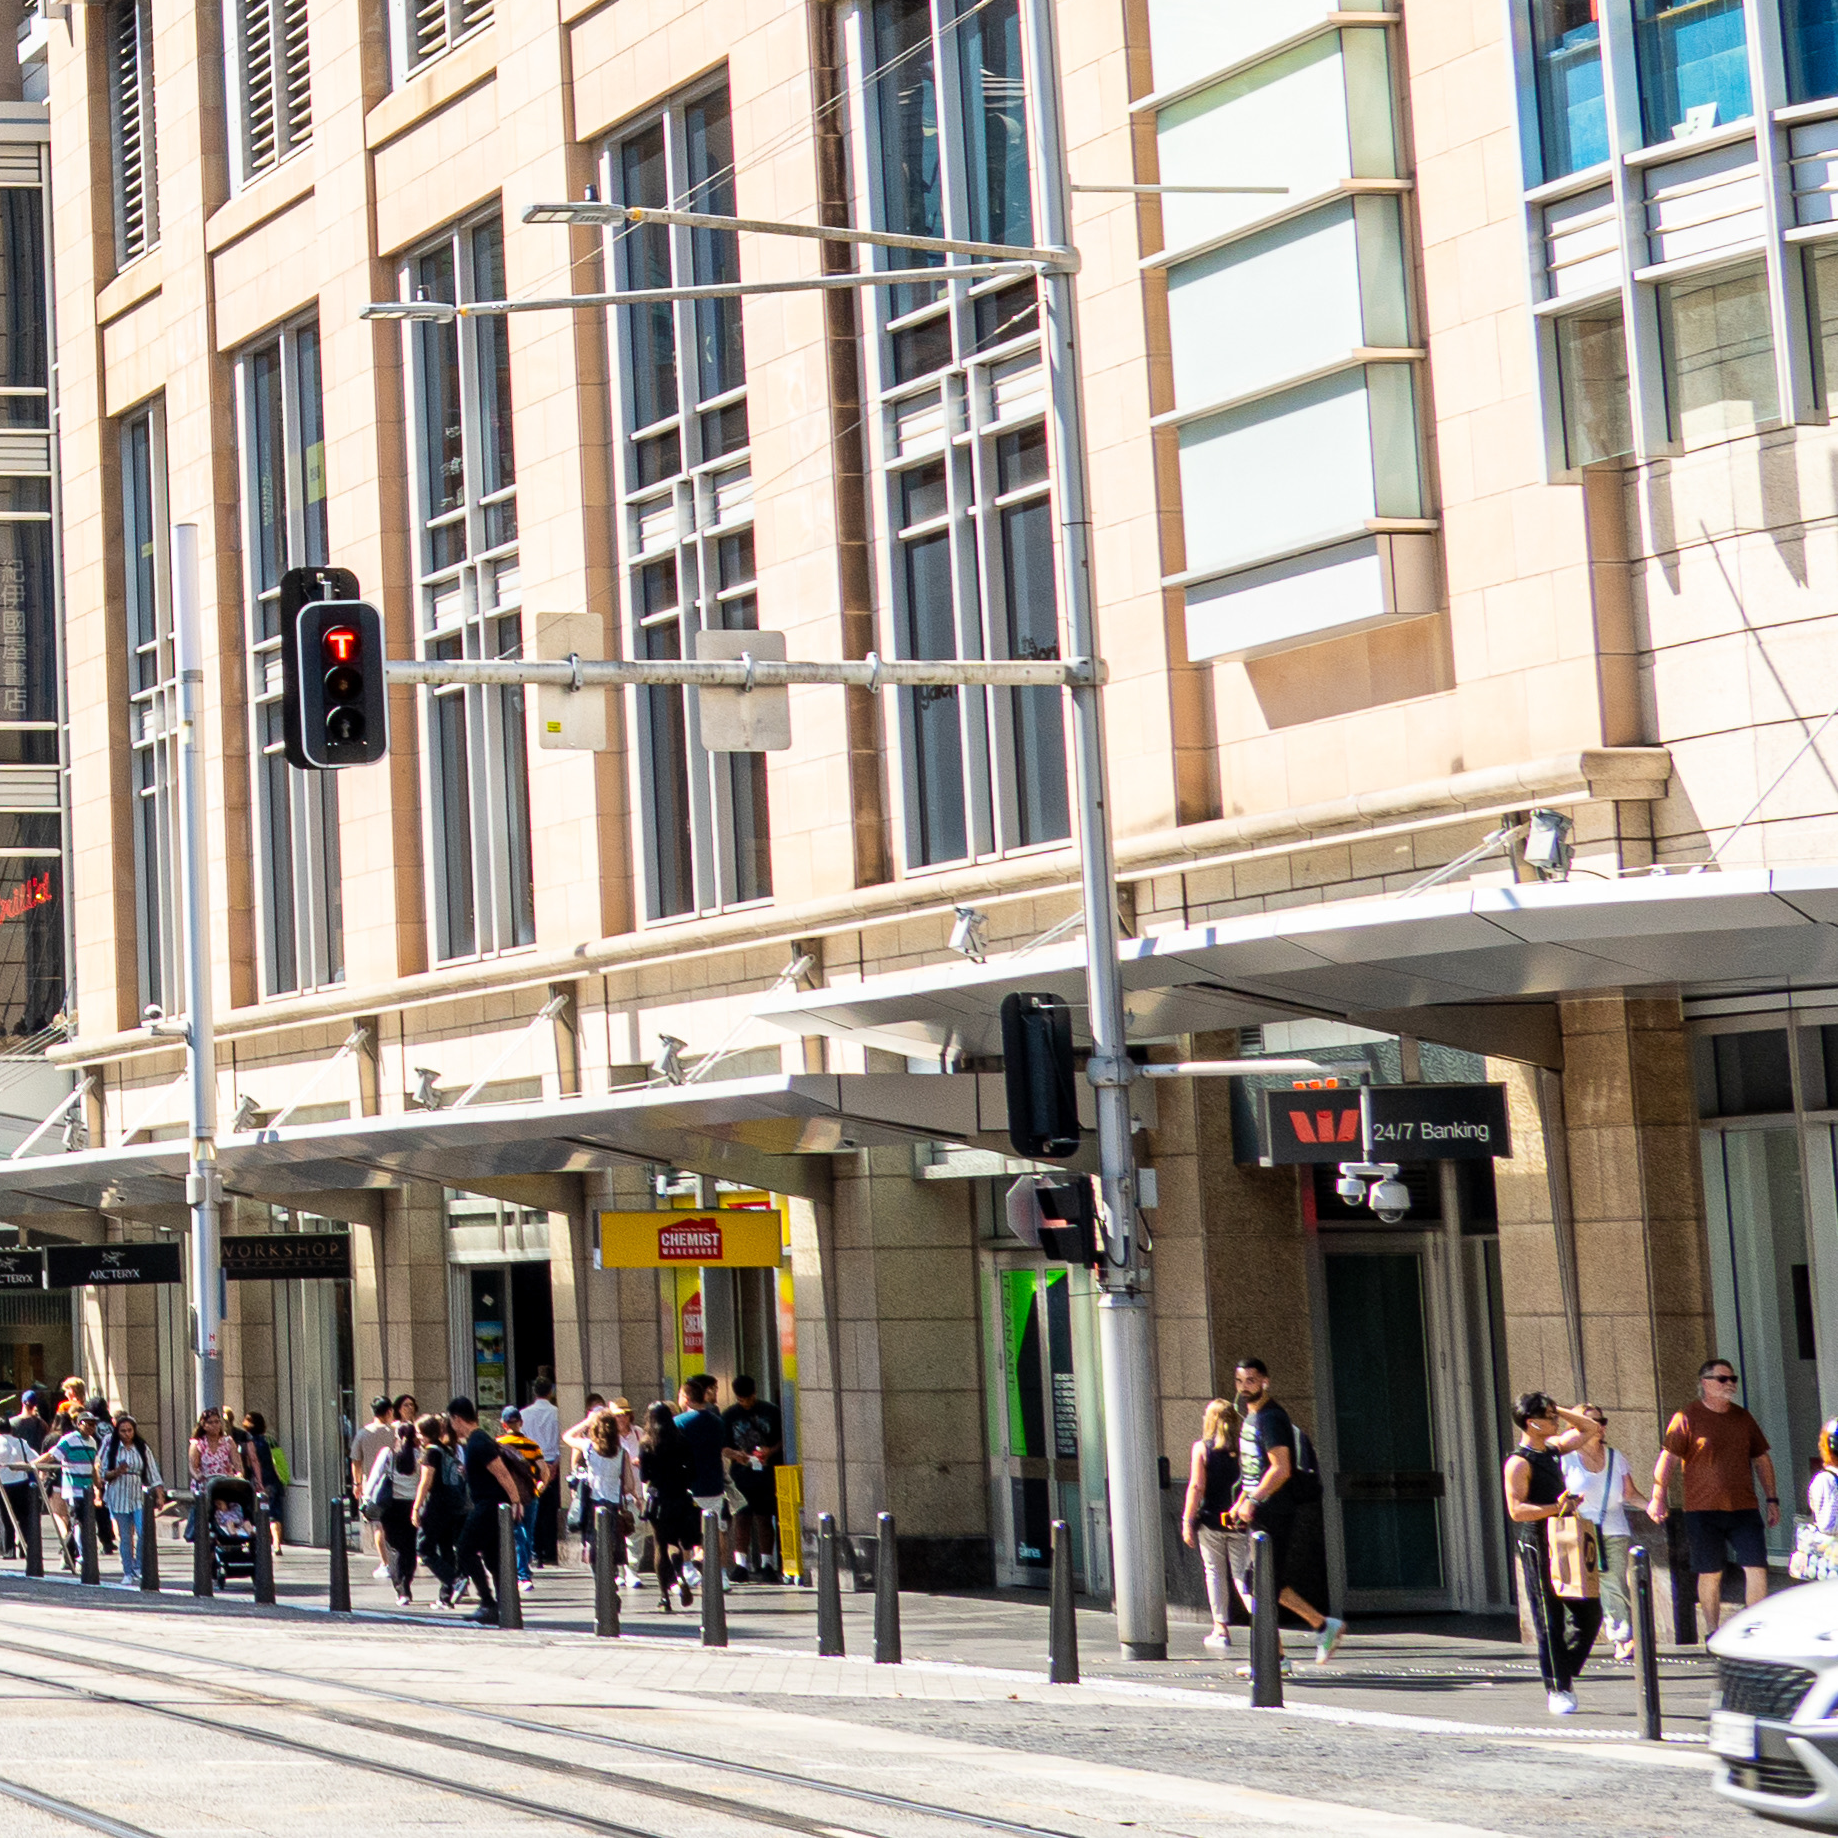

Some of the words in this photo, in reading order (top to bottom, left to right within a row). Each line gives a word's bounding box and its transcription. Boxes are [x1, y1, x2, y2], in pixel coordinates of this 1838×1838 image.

[1374, 1123, 1414, 1140] 24/7
[1421, 1121, 1489, 1142] Banking
[661, 1232, 719, 1246] CHEMIST
